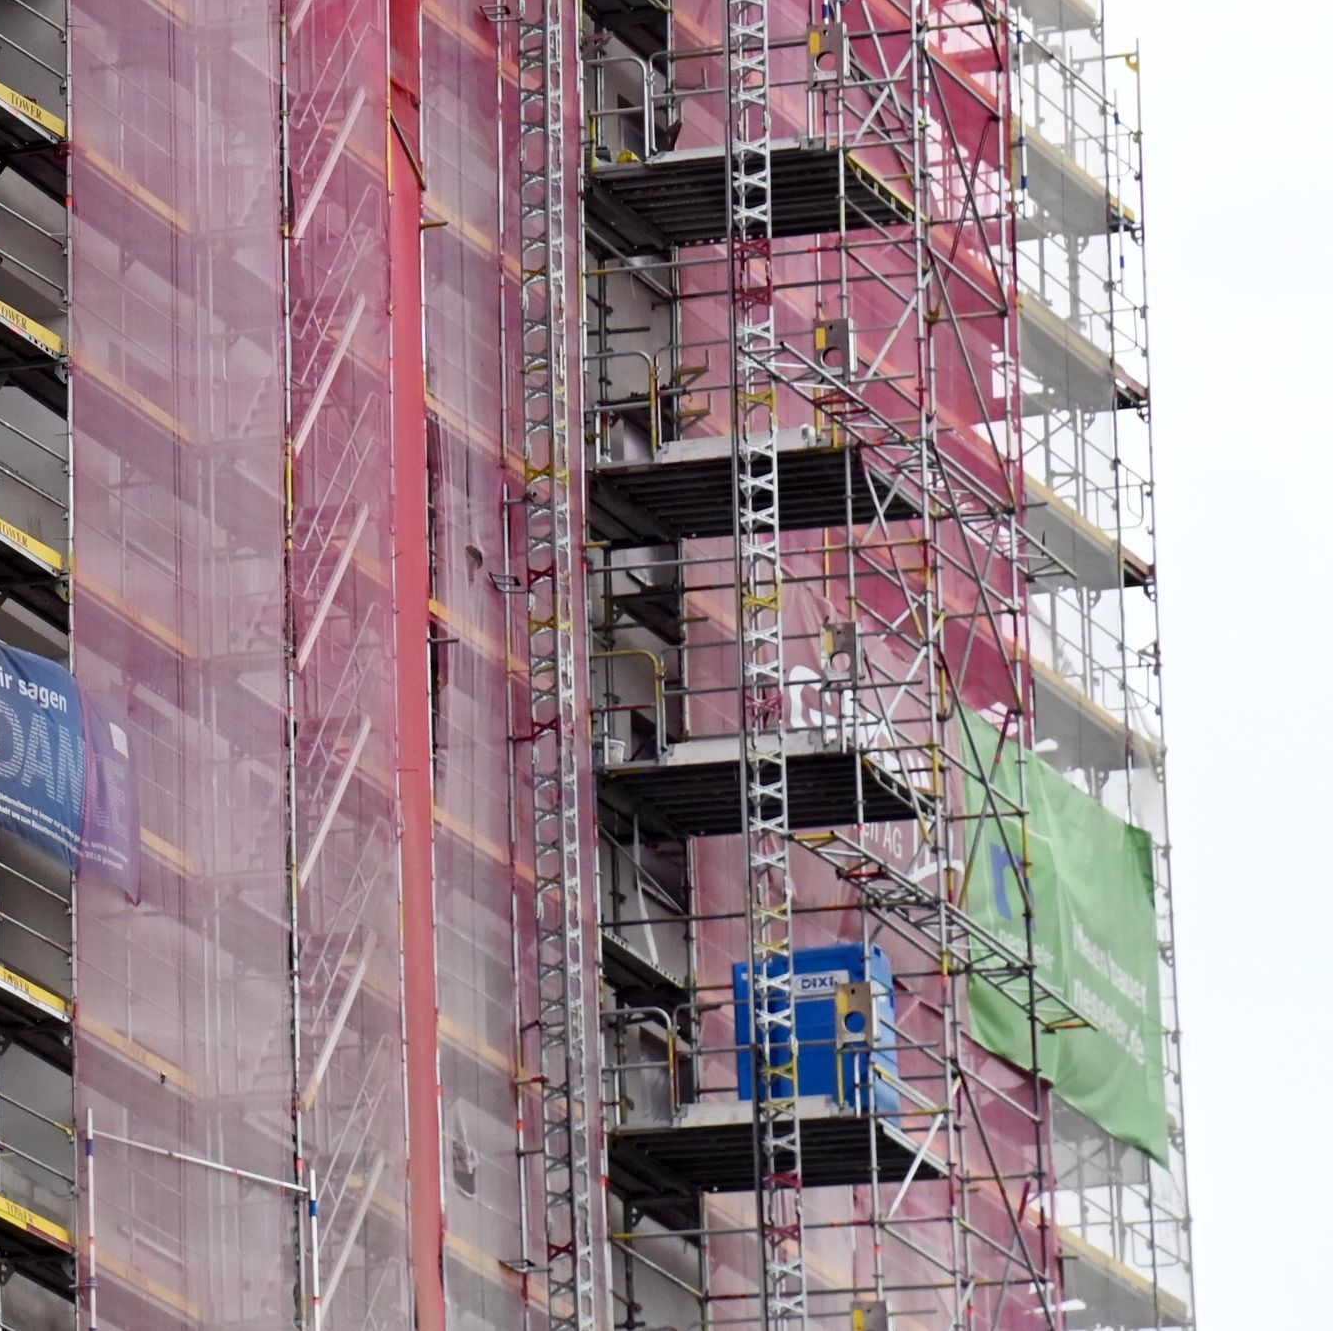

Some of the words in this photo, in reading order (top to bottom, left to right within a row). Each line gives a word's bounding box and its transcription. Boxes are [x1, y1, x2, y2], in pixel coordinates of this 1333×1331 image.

[9, 92, 43, 122] TOWER
[18, 678, 67, 713] sagen
[883, 823, 902, 859] AG
[802, 976, 834, 989] DIXI
